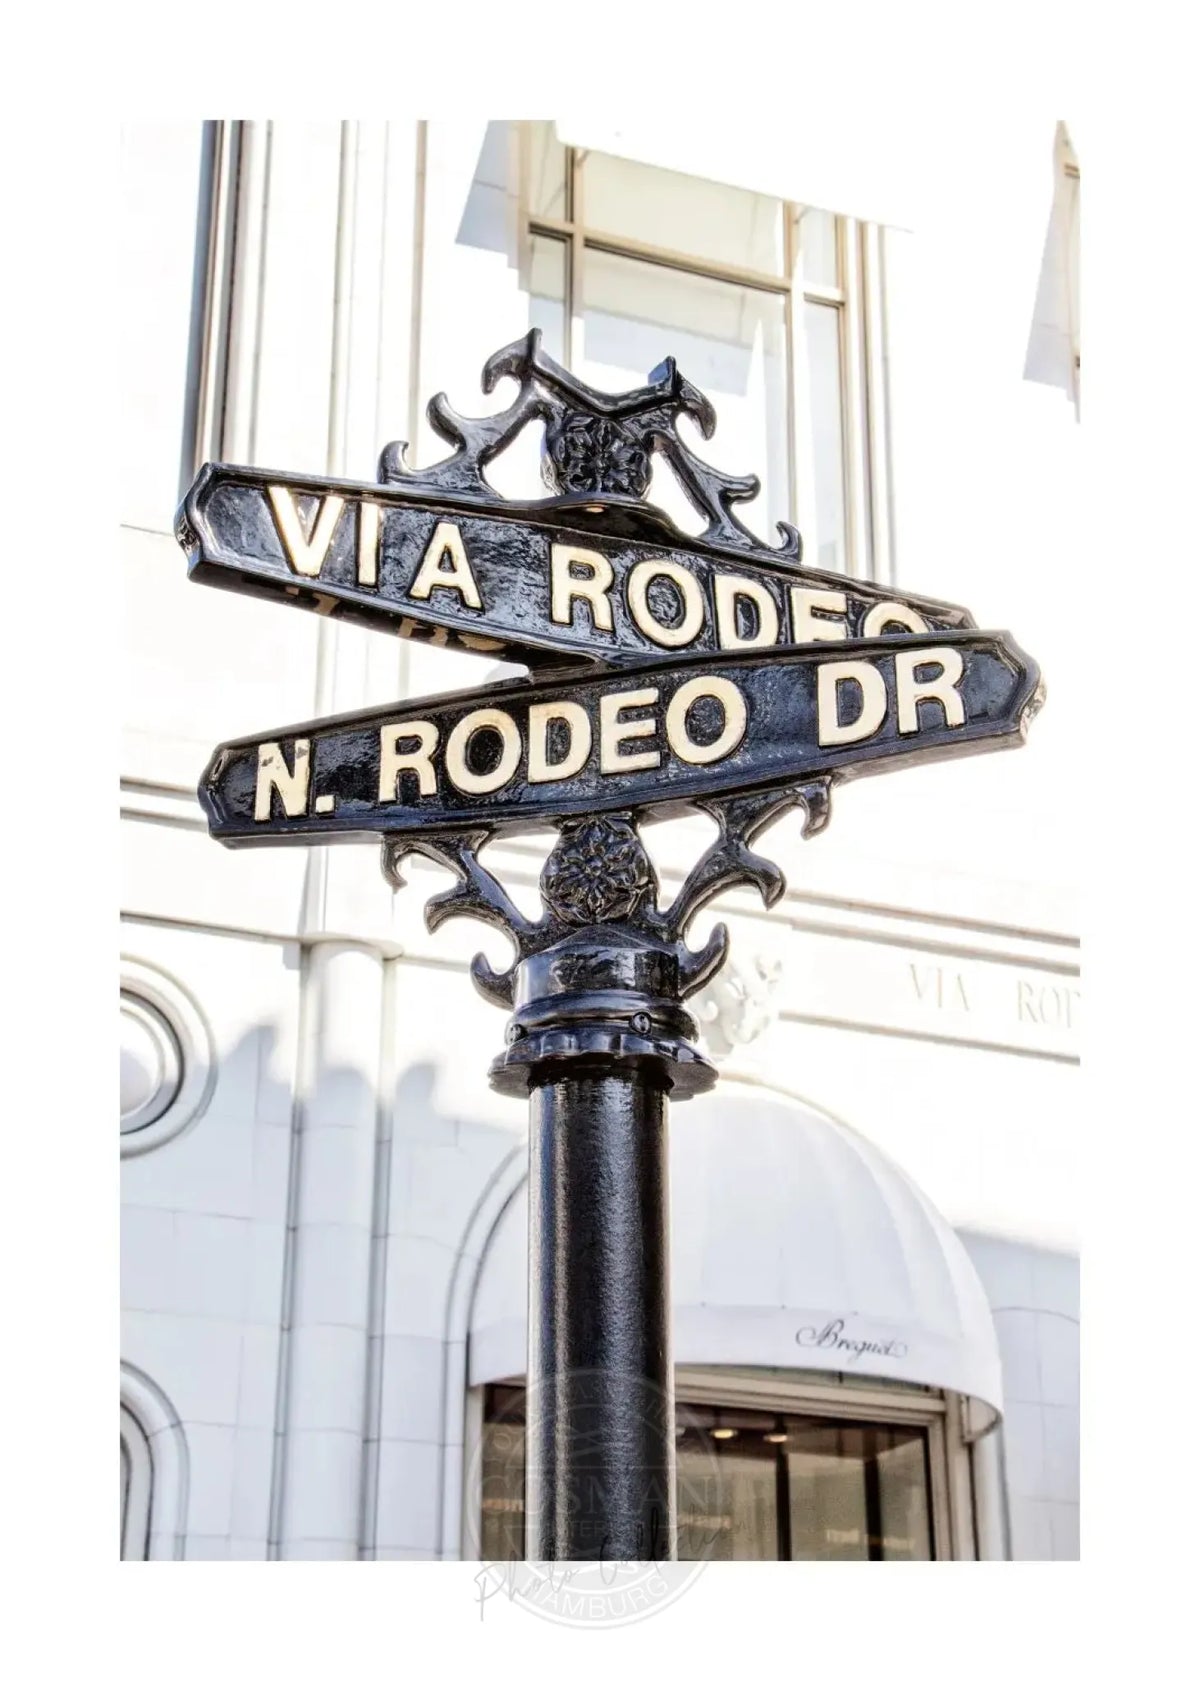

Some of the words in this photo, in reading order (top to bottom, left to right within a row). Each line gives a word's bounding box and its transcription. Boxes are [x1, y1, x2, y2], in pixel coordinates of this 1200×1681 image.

[264, 485, 483, 609] VIA
[253, 740, 335, 823] N.
[379, 675, 748, 803] RODEO
[817, 647, 967, 748] DR
